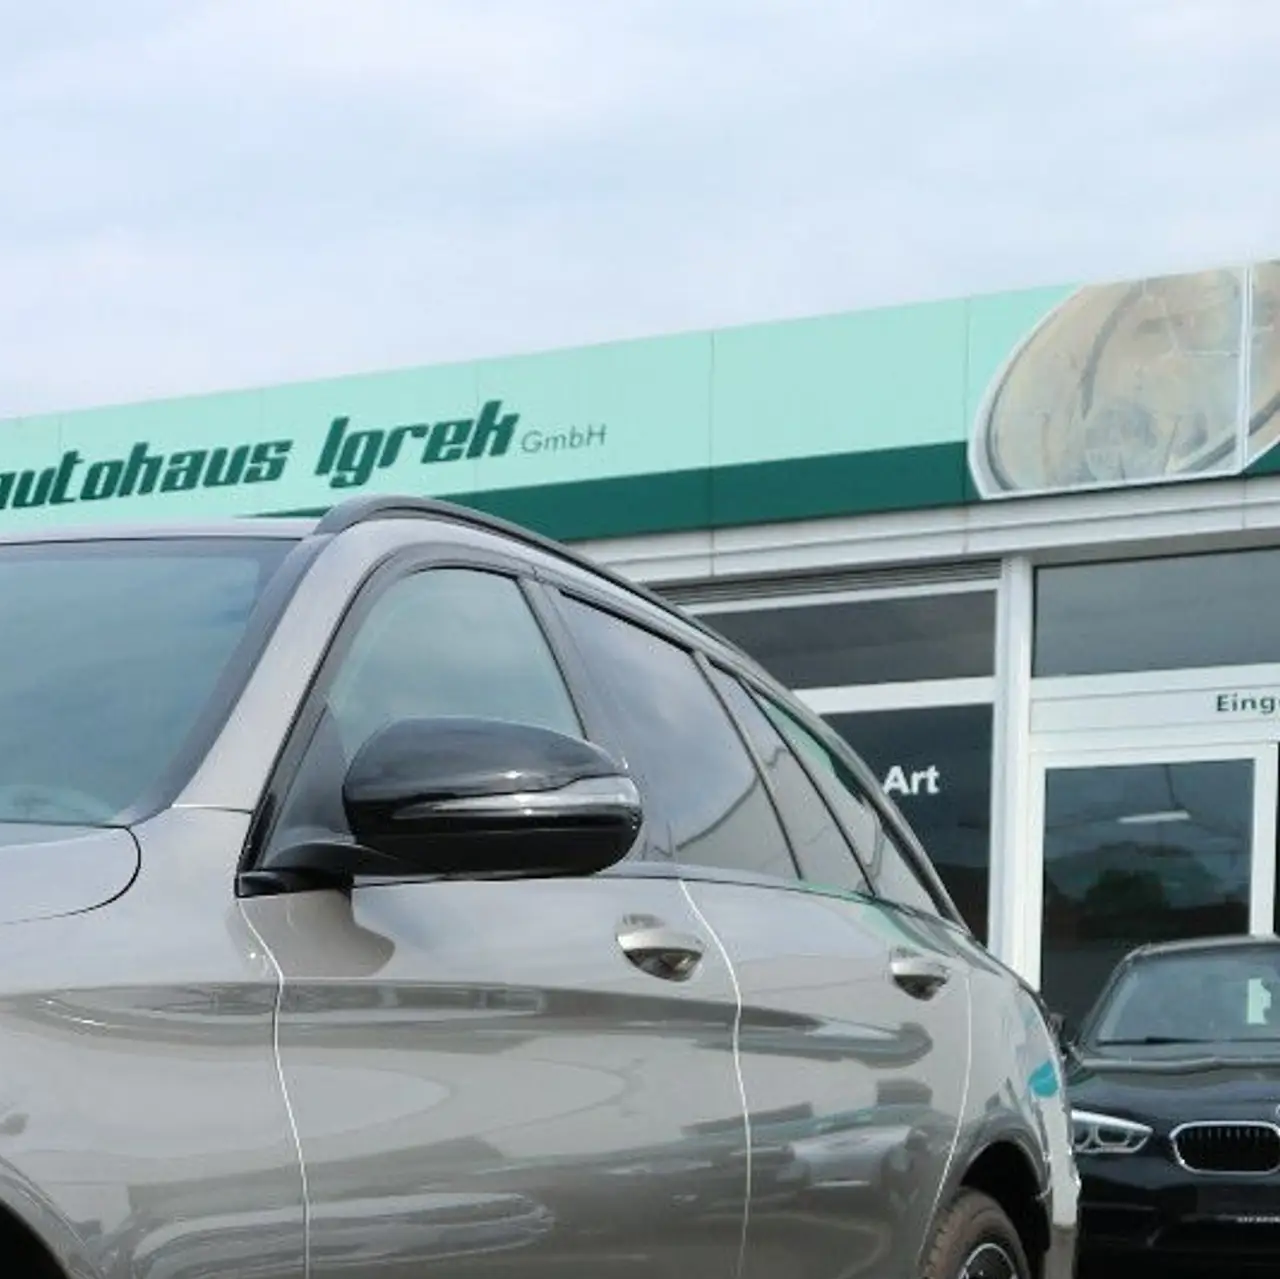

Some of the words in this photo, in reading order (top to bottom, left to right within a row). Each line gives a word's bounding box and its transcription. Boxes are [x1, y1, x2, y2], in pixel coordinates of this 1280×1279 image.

[314, 399, 521, 489] Igrek
[521, 424, 607, 453] GmbH
[1216, 693, 1280, 715] Eing
[882, 764, 940, 795] Art
